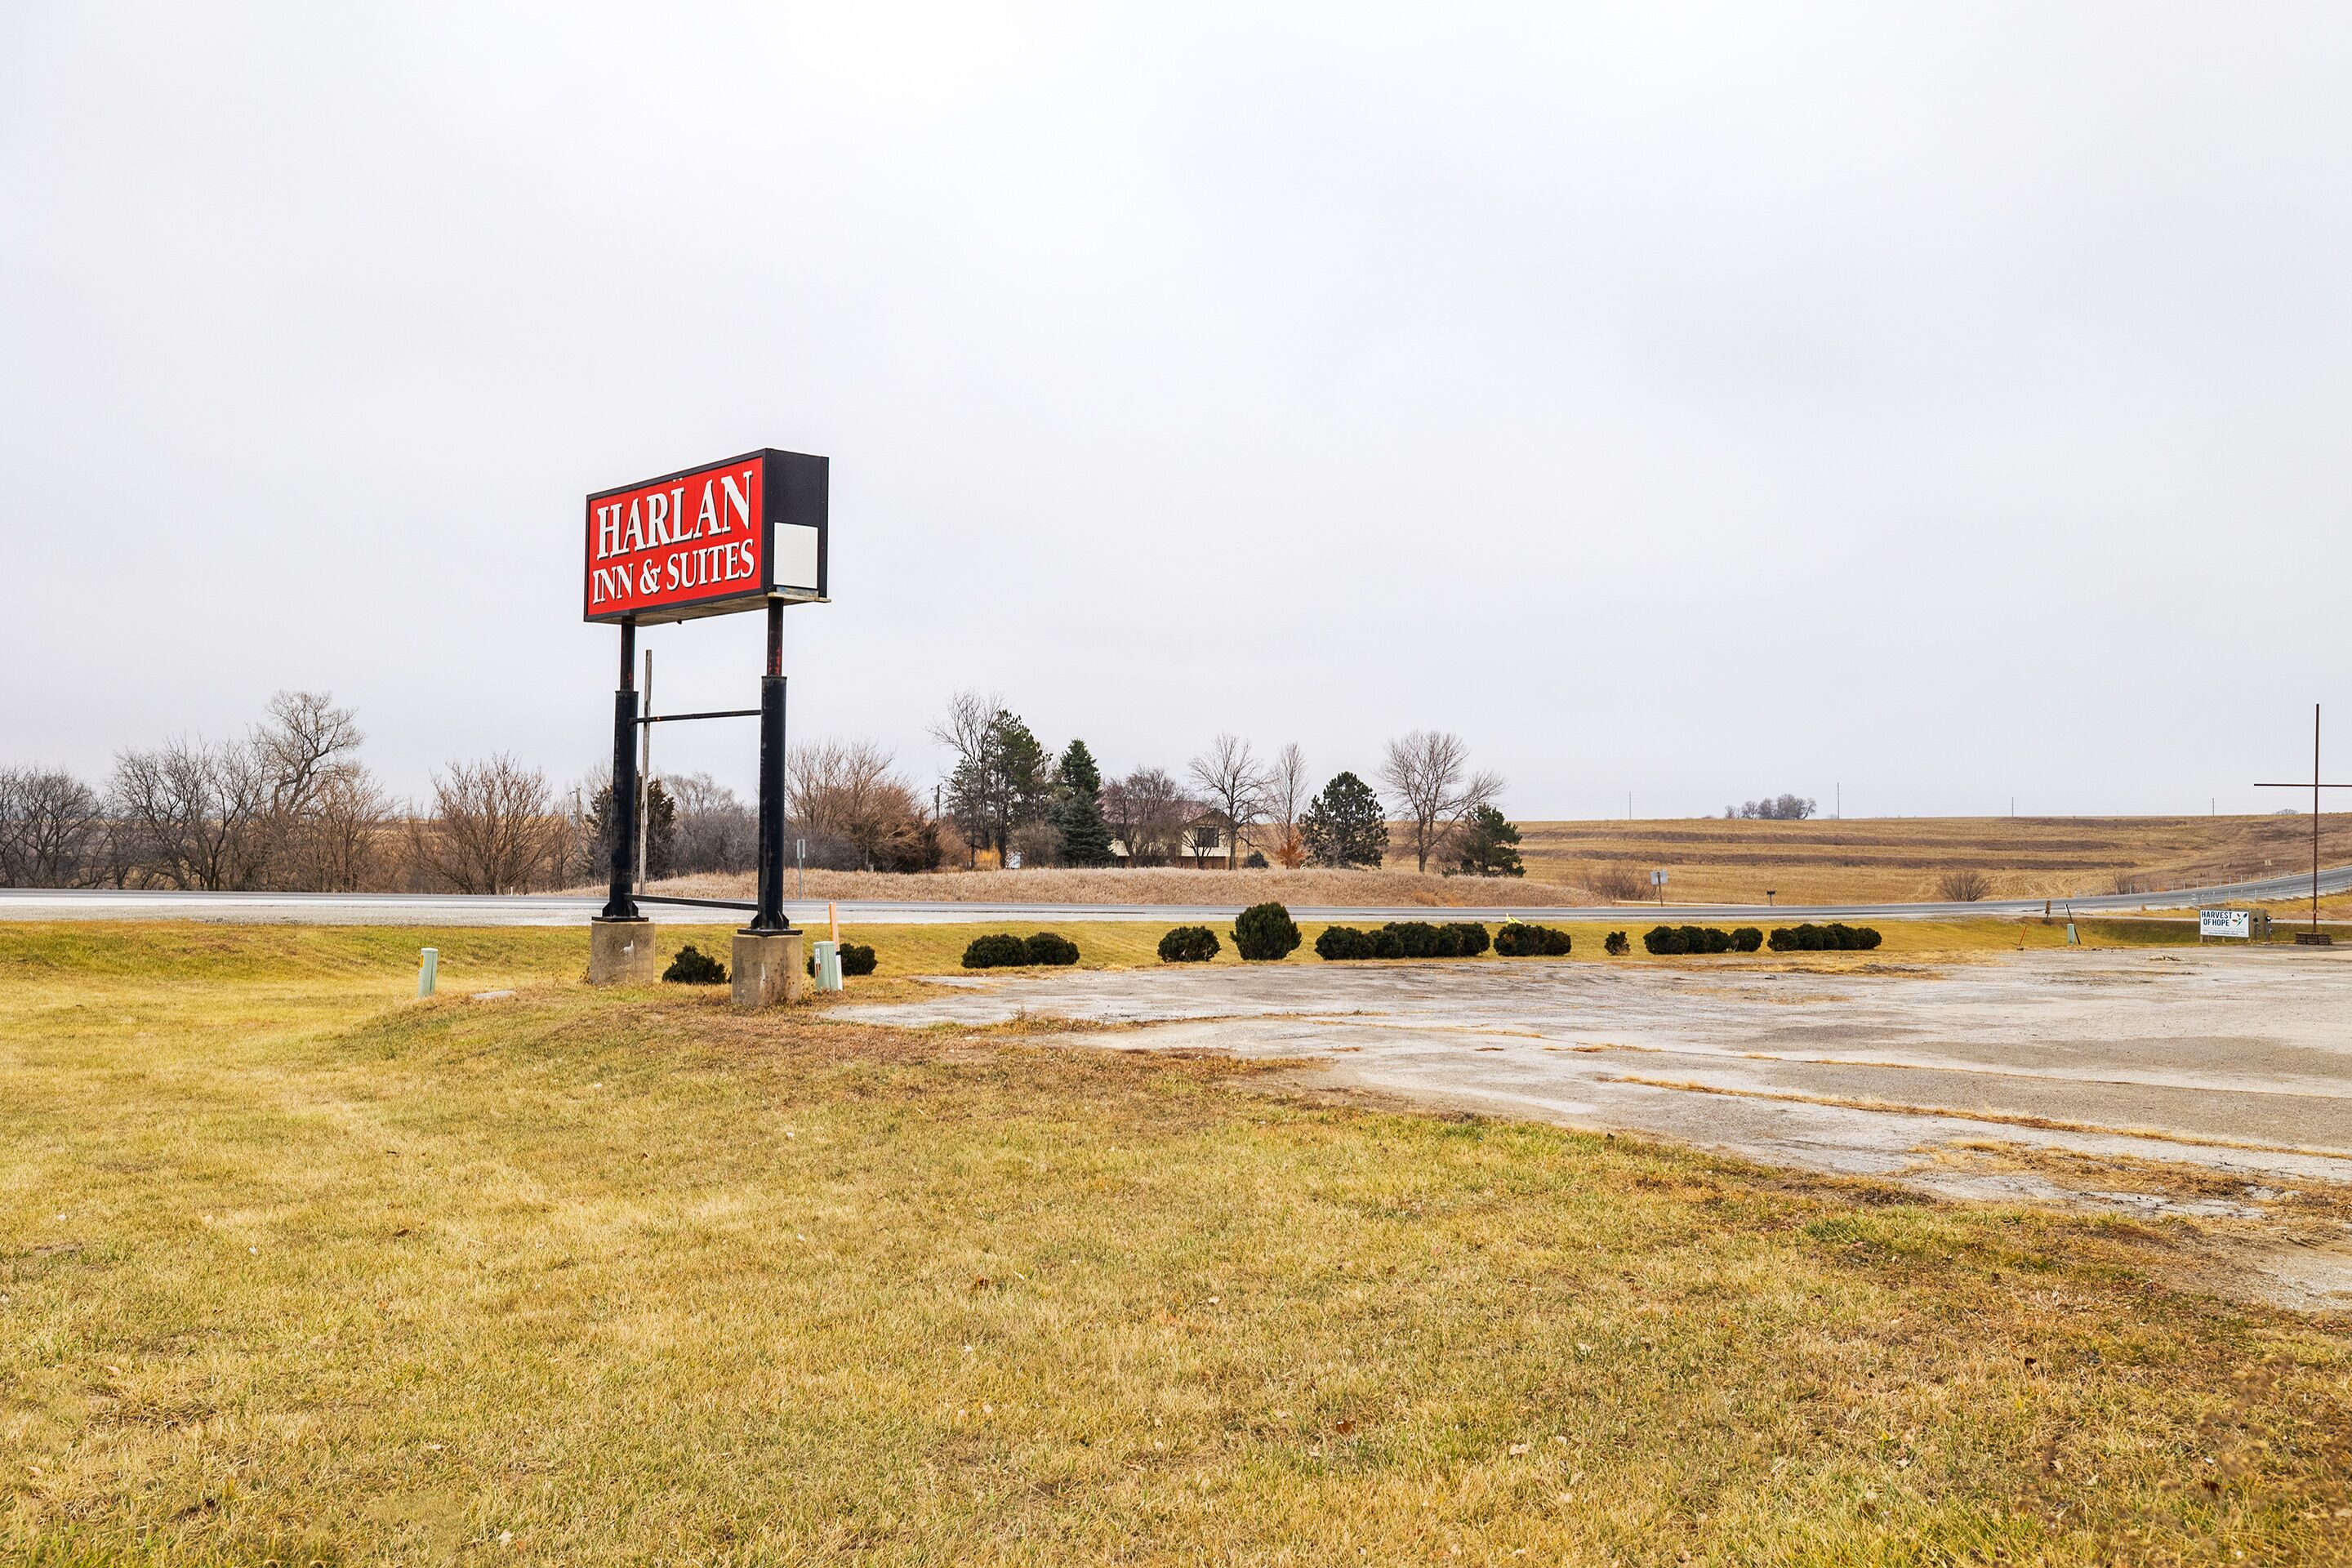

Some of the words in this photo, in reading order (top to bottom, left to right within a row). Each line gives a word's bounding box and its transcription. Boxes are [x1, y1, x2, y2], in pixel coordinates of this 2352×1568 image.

[596, 470, 753, 561] HARLAN
[593, 564, 634, 604] INN
[639, 559, 662, 595] &
[666, 538, 755, 590] SUITES
